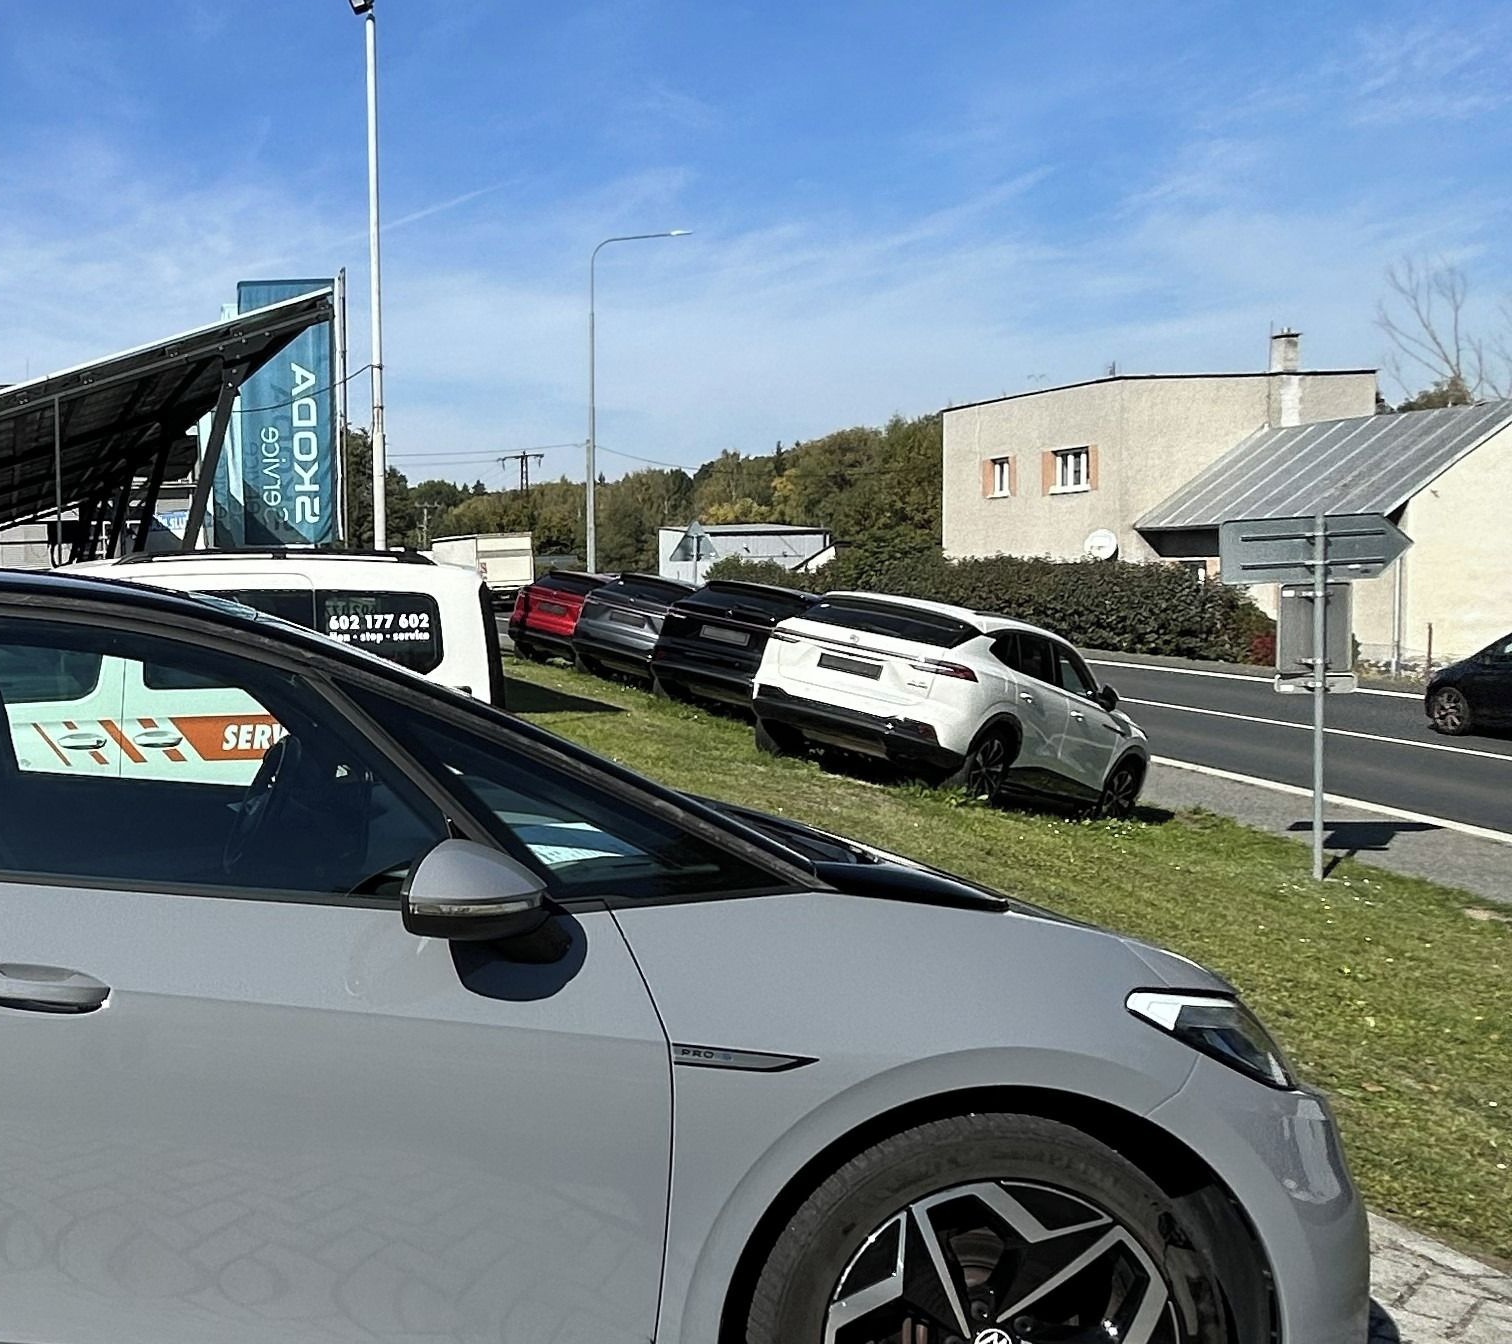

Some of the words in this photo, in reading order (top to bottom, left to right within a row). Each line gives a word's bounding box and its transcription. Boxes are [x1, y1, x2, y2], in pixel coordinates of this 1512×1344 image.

[329, 614, 360, 630] 602
[365, 613, 394, 629] 177
[398, 613, 430, 628] 602
[359, 631, 384, 644] stop
[392, 629, 430, 641] service
